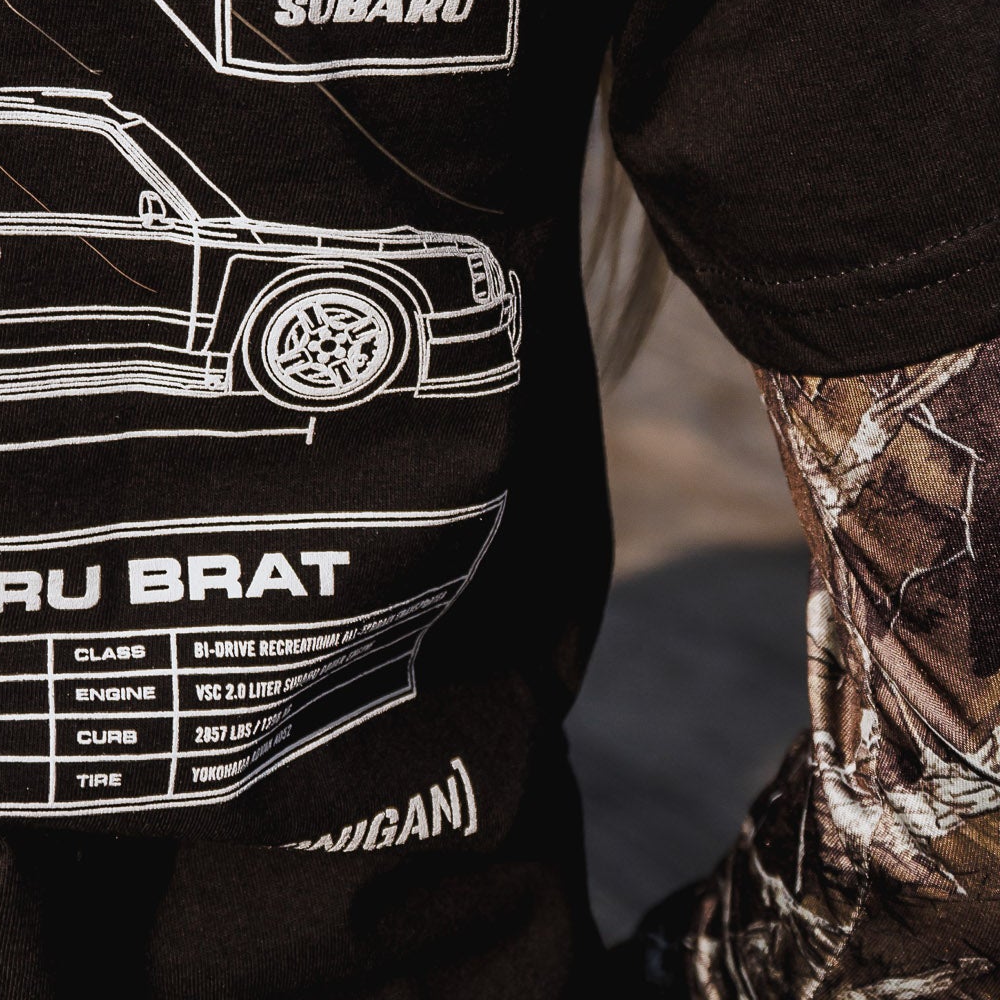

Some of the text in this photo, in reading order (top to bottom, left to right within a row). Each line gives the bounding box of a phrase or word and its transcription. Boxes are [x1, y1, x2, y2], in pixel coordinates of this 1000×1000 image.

[128, 550, 351, 605] BRAT
[74, 645, 146, 662] CLASS
[194, 640, 257, 658] BI-DRIVE
[259, 632, 340, 657] RECREATIONAL
[75, 686, 157, 702] ENGINE
[196, 684, 222, 701] VSC
[225, 683, 246, 701] 2.0
[249, 680, 282, 699] LITER
[76, 730, 138, 745] CURB
[229, 722, 253, 741] LBS
[76, 773, 123, 788] TIRE
